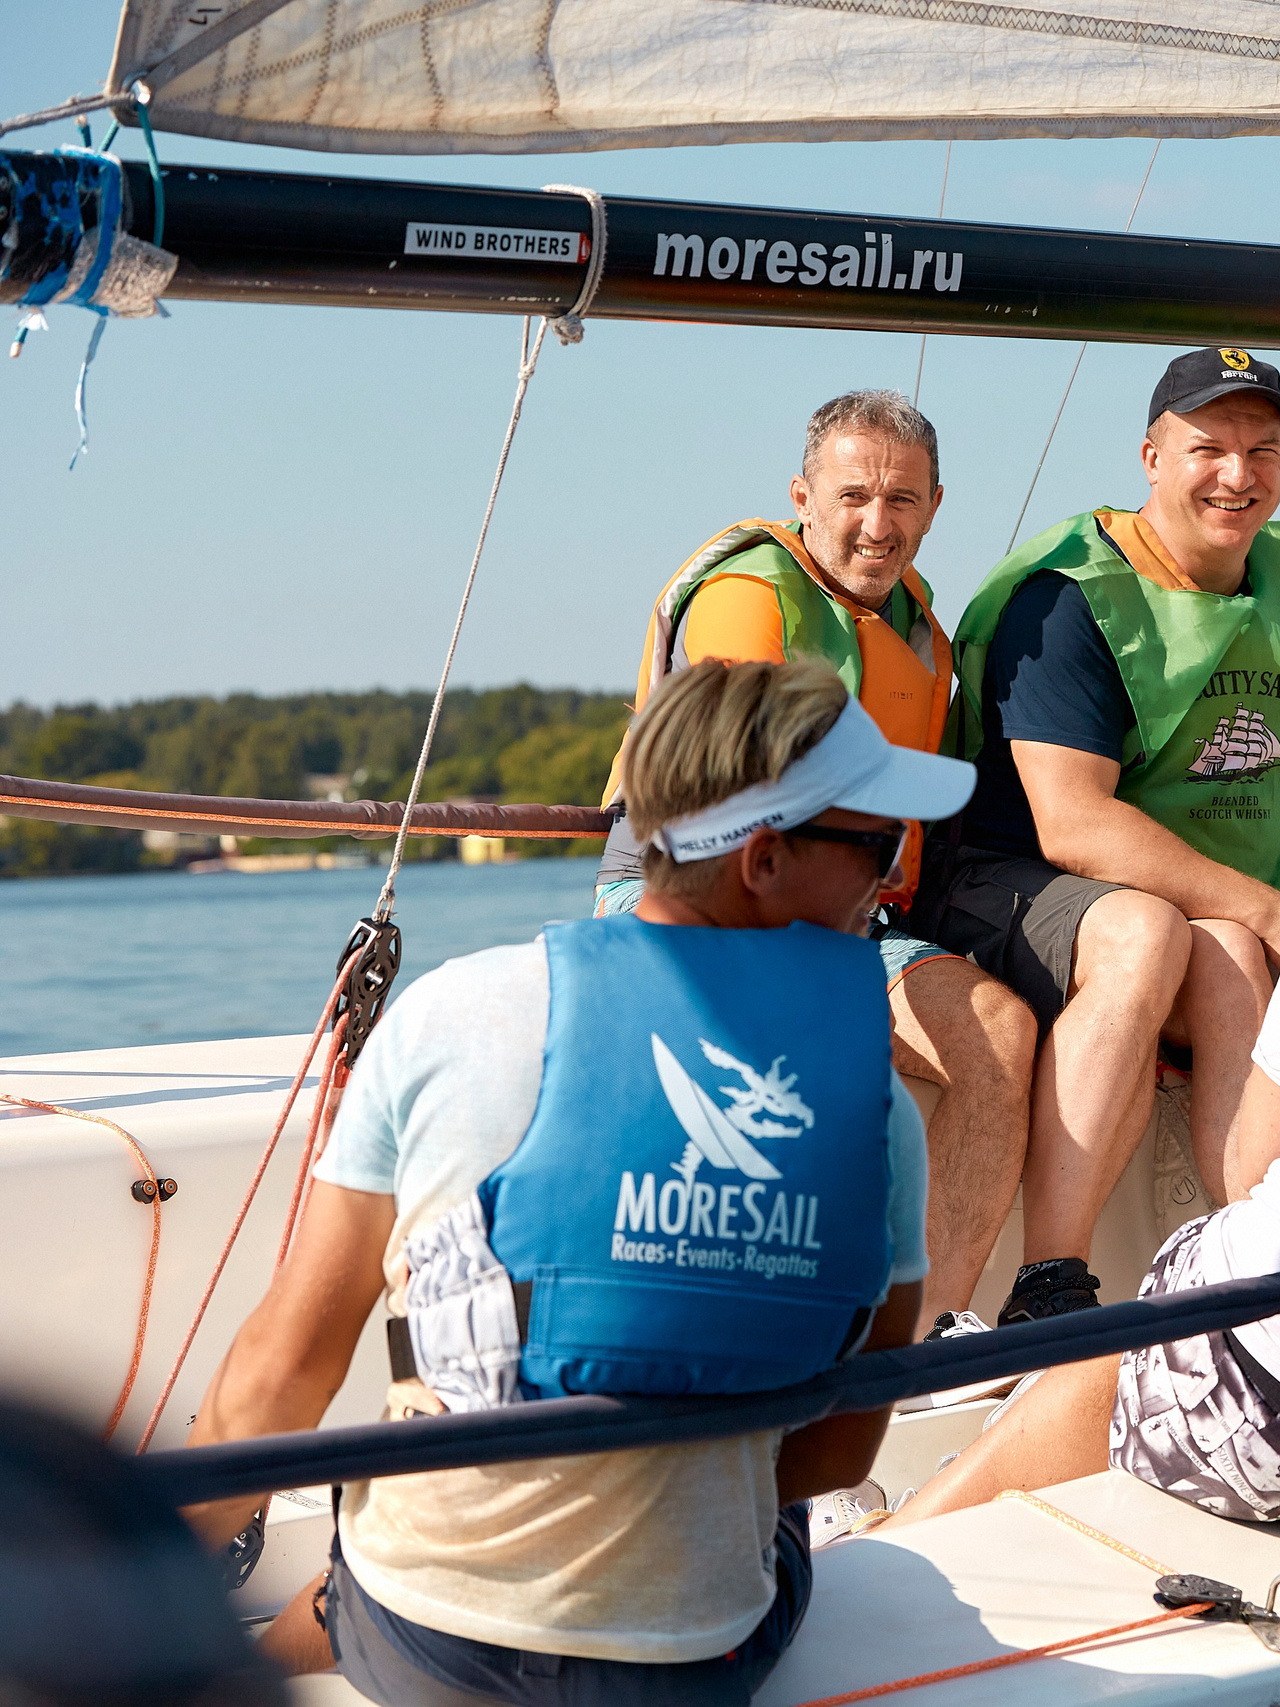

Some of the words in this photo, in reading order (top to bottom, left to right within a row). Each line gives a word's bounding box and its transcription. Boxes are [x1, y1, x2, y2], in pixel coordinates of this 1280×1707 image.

[416, 229, 467, 249] WIND
[474, 232, 572, 256] BROTHERS
[653, 231, 964, 292] moresail.ru
[1188, 809, 1232, 820] SCOTCH
[1211, 796, 1260, 806] BLENDED
[678, 835, 718, 851] HELLY
[721, 811, 784, 845] HANSEN
[1216, 1447, 1235, 1475] SIXTY
[1232, 1473, 1250, 1493] NINE
